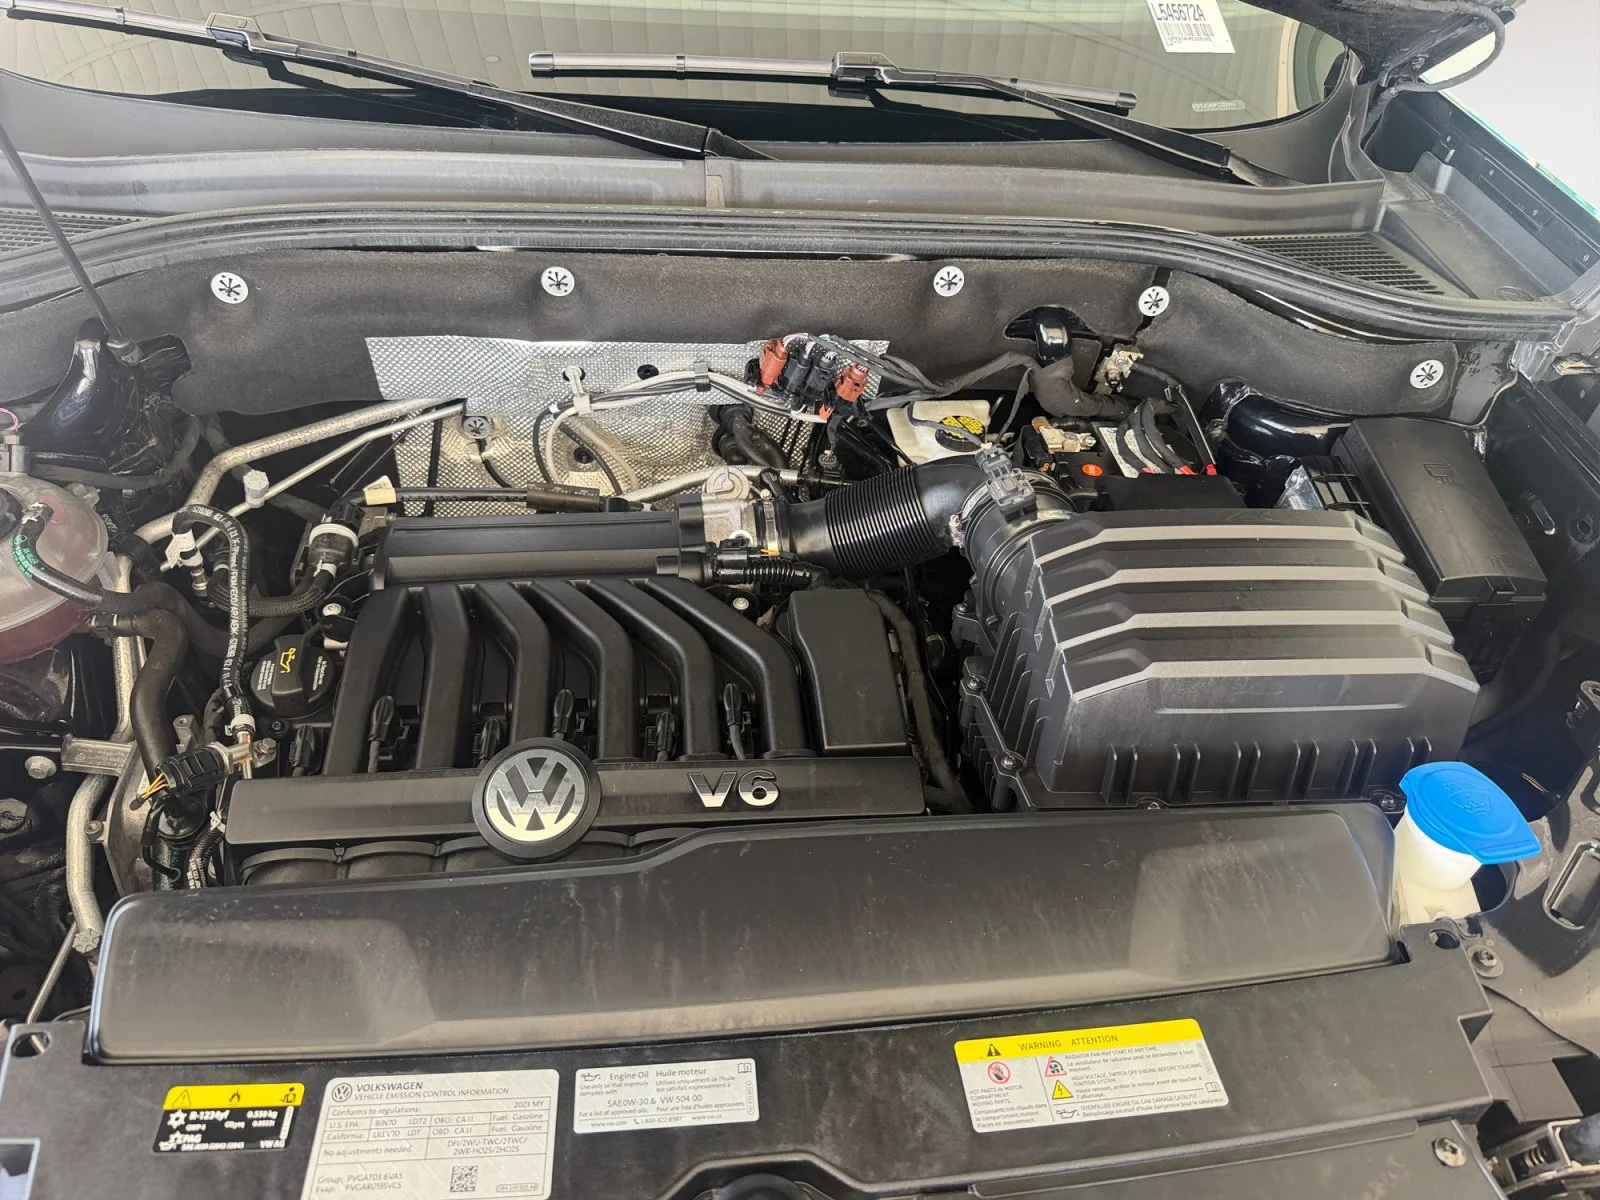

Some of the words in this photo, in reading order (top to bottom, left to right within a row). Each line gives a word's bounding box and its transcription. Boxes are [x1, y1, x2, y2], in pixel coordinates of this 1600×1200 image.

[1151, 3, 1206, 21] L545672A
[688, 770, 779, 808] V6
[1019, 1039, 1061, 1051] WARNING
[1071, 1034, 1118, 1046] ATTENTION
[609, 1072, 636, 1082] Engine
[638, 1071, 649, 1079] Oil
[656, 1069, 676, 1077] Huile
[678, 1068, 707, 1076] moteur
[357, 1081, 423, 1092] VOLKSWAGEN
[355, 1093, 383, 1101] VEHICLE
[385, 1091, 421, 1099] EMISSION
[422, 1090, 457, 1098] CONTROL
[458, 1087, 510, 1096] INFORMATION
[650, 1096, 657, 1105] &
[660, 1095, 675, 1104] VW
[675, 1095, 691, 1103] 504
[692, 1094, 703, 1102] 00
[332, 1108, 368, 1117] Conforms
[369, 1107, 377, 1115] to
[375, 1119, 397, 1127] BIN70
[409, 1117, 428, 1125] LDT2
[512, 1112, 544, 1120] Gasoline
[407, 1129, 421, 1137] LDT
[511, 1124, 543, 1132] Gasoline
[324, 1149, 334, 1157] No
[335, 1147, 383, 1157] adjustments
